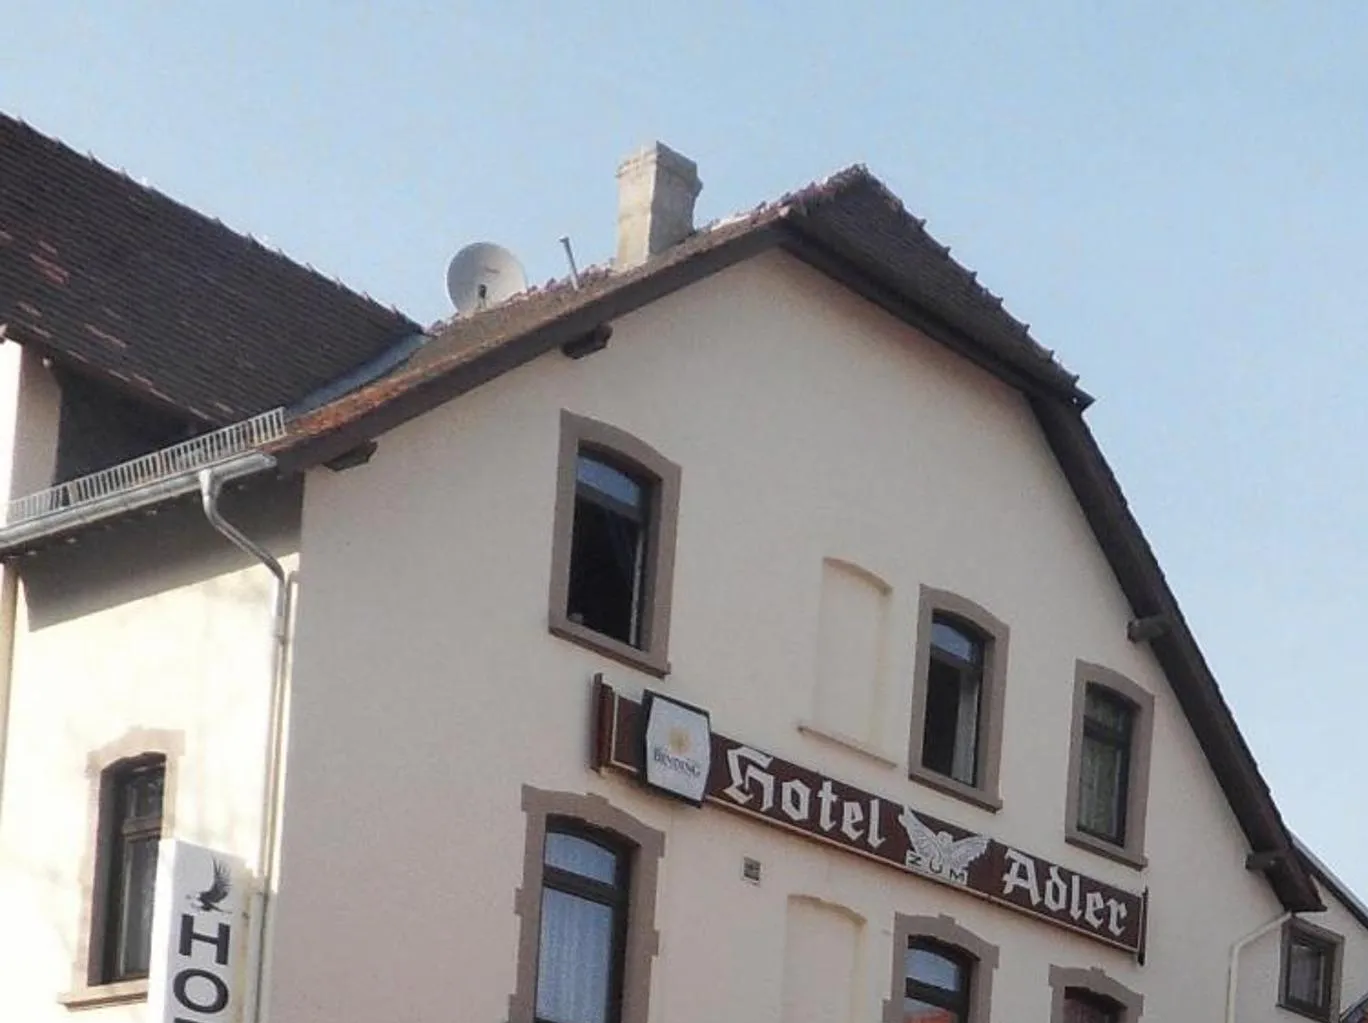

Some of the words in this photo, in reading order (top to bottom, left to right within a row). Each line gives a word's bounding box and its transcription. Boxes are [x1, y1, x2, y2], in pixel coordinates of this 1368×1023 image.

[724, 744, 886, 849] Hotel
[907, 853, 966, 883] ZUM
[1002, 849, 1128, 937] Adler
